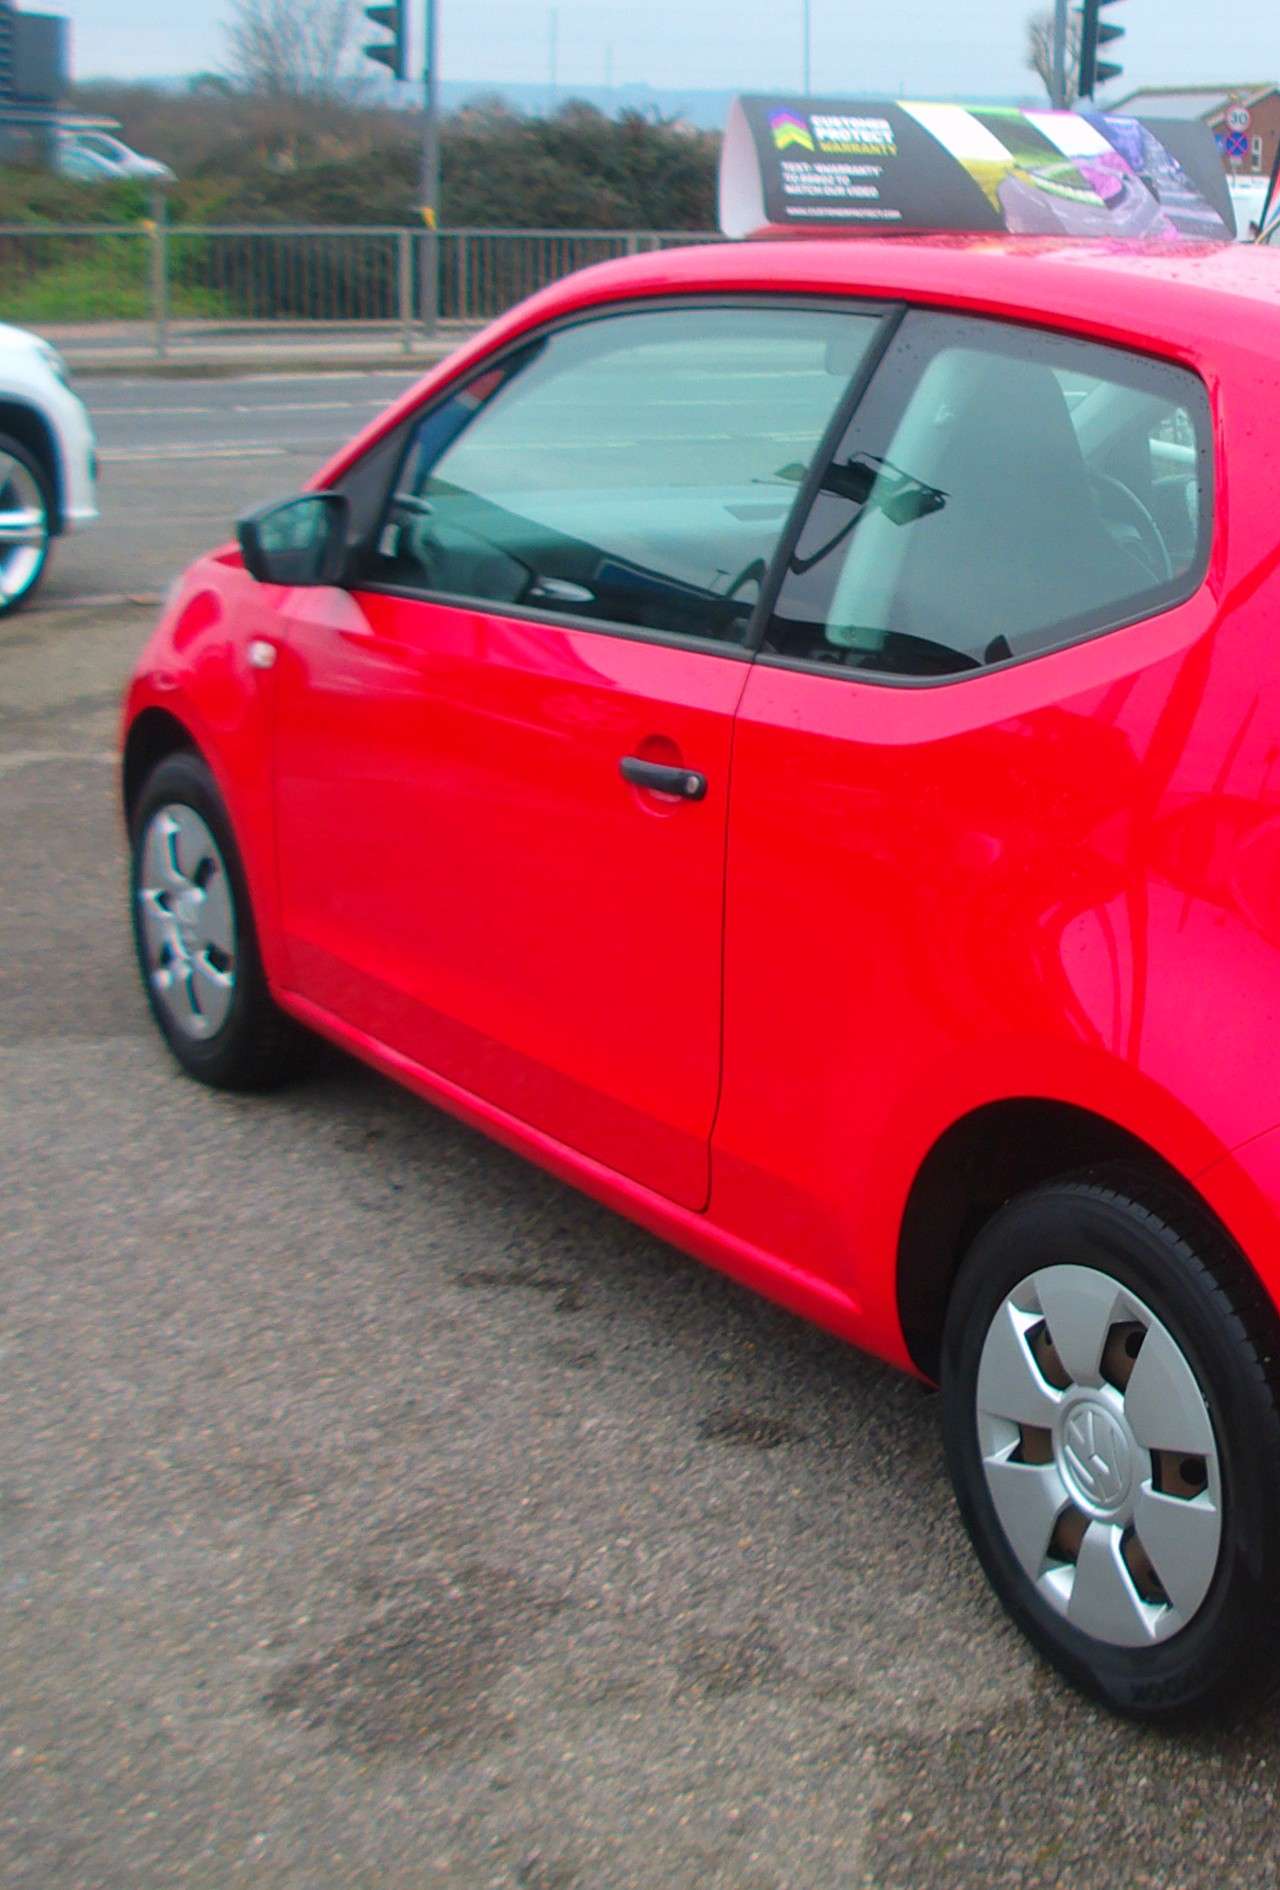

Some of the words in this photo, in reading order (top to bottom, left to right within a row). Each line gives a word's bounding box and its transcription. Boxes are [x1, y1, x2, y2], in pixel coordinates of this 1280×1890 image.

[1231, 111, 1248, 125] 30
[814, 127, 895, 143] PROTECT
[819, 141, 897, 155] WARRANTY
